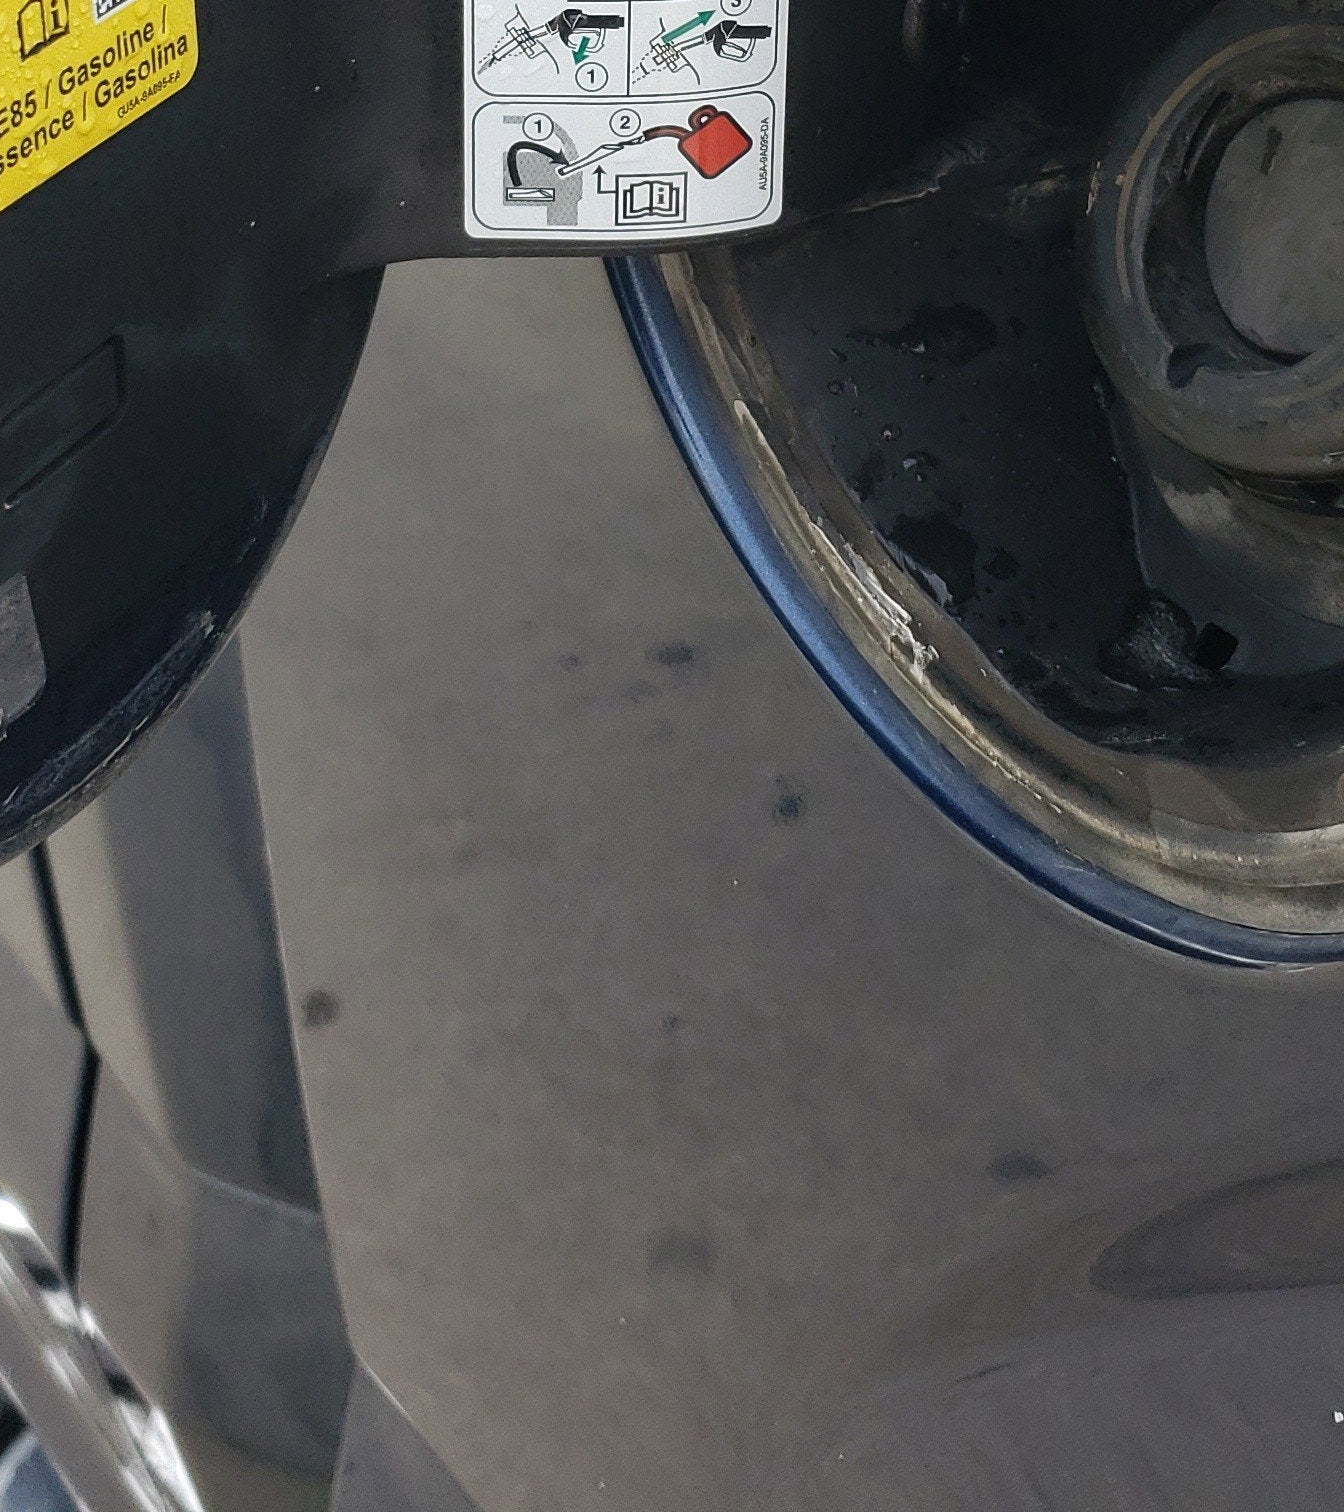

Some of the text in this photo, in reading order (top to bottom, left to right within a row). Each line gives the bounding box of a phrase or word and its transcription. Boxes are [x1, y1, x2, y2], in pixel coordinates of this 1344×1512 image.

[58, 20, 155, 96] Gasoline
[94, 33, 188, 109] Gasolina
[586, 68, 595, 84] 1
[533, 119, 543, 135] 1
[619, 115, 631, 130] 2
